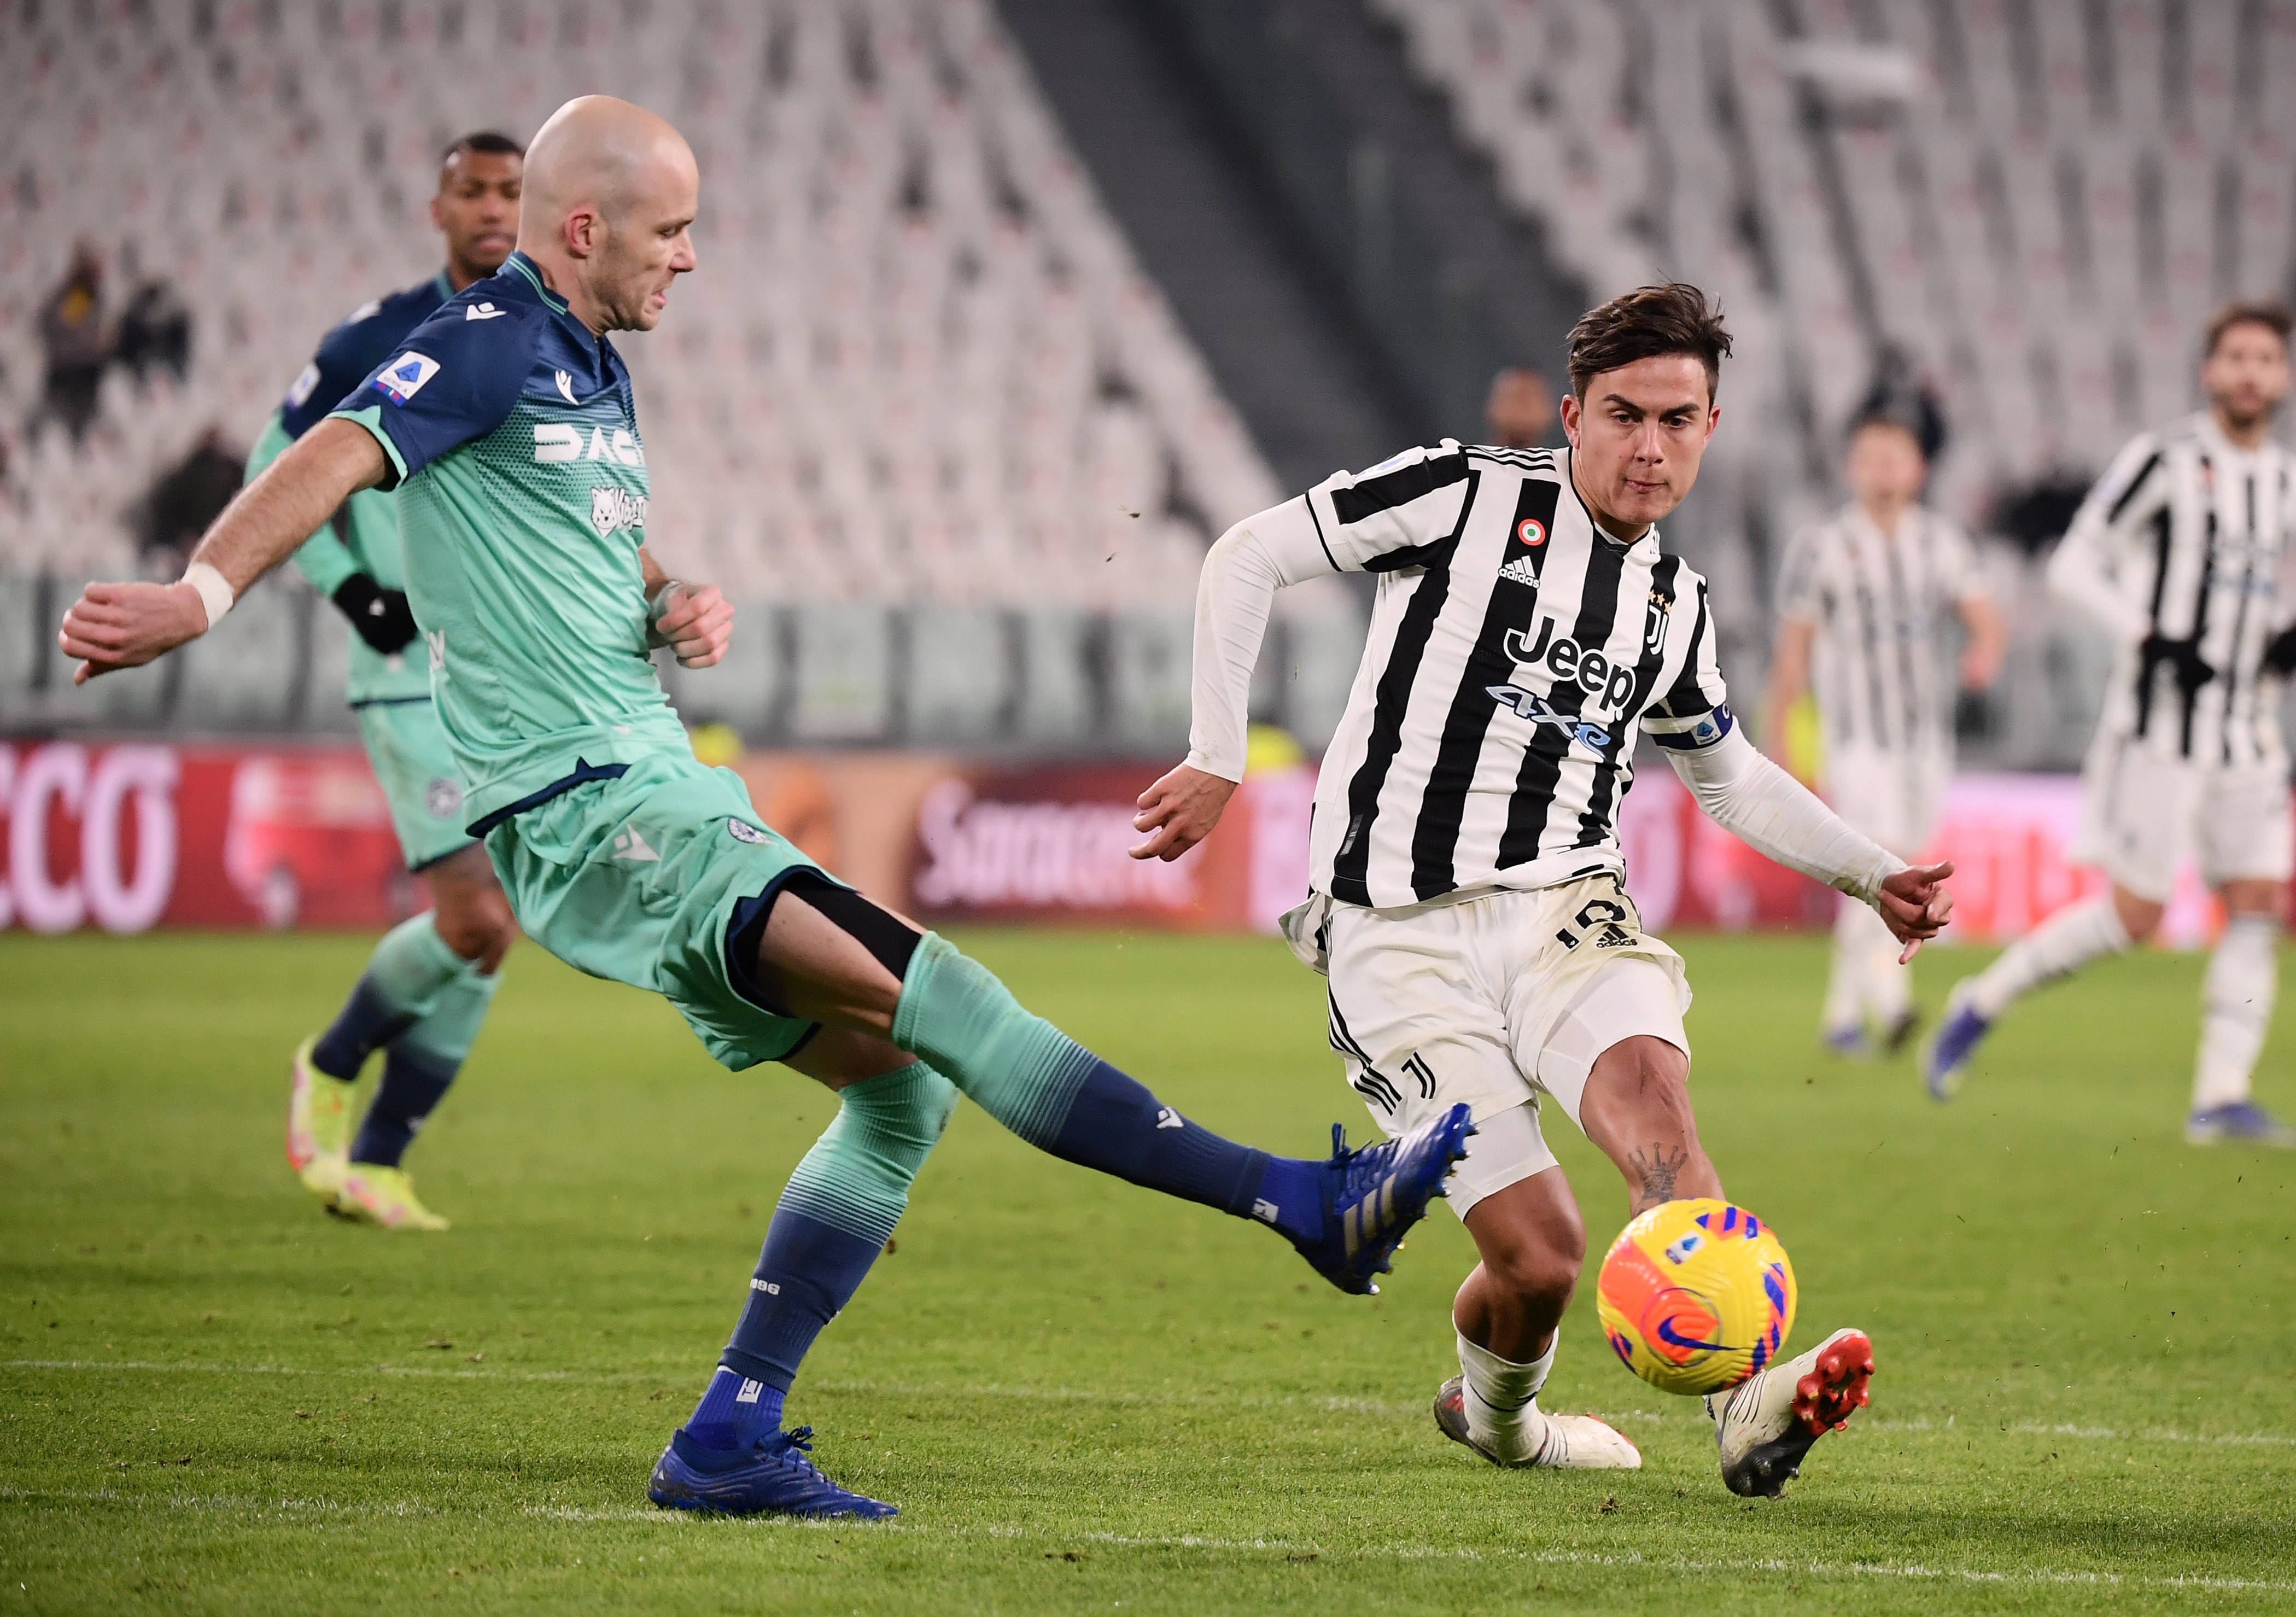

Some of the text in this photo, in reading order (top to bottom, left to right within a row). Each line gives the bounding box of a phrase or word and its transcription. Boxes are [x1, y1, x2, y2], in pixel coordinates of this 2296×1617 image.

[1498, 568, 1540, 588] adidas
[1505, 615, 1635, 713] Jeep
[0, 742, 180, 935] CO
[1596, 938, 1638, 949] adidas
